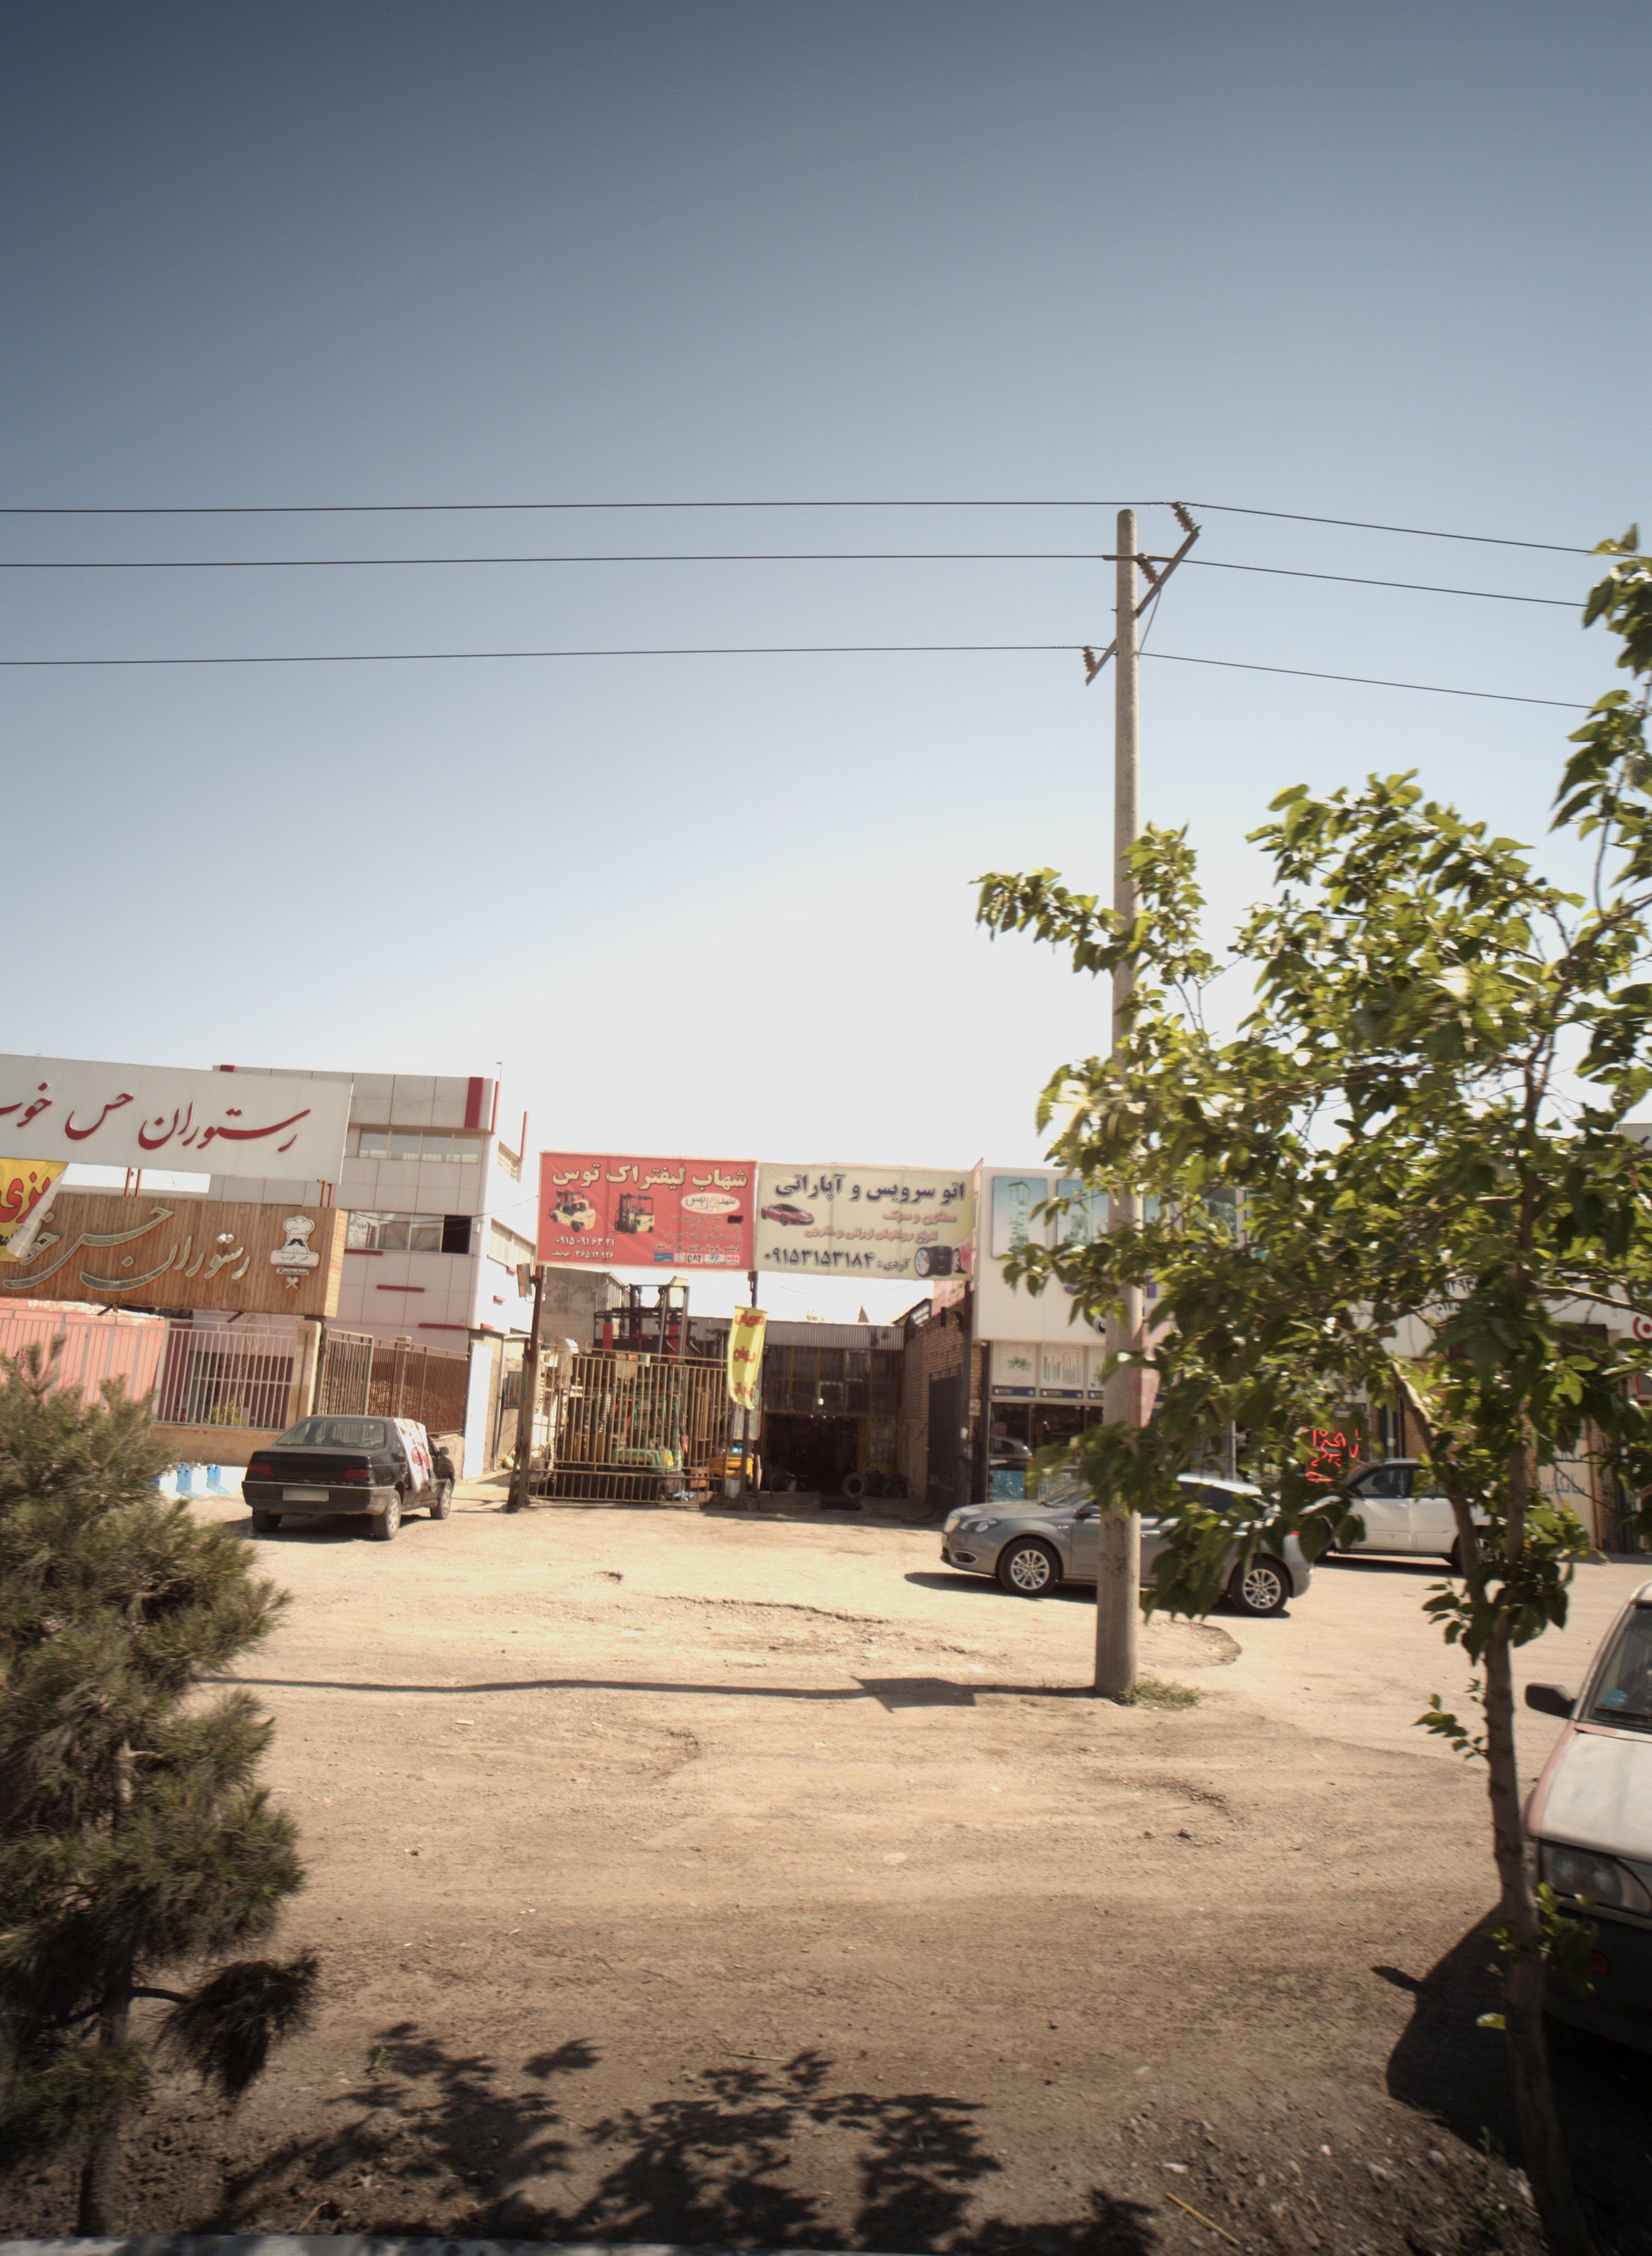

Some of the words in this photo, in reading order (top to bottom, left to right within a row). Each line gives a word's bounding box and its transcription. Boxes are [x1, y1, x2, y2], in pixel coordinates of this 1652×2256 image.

[64, 1093, 135, 1140] حس
[138, 1102, 311, 1152] رستوران
[552, 1163, 601, 1187] توس
[606, 1164, 687, 1190] لیفتراک
[692, 1168, 748, 1191] شهاب
[775, 1174, 847, 1201] آپاراتی
[850, 1184, 861, 1201] و
[866, 1184, 936, 1203] سرویس
[941, 1181, 966, 1205] اتو
[883, 1210, 912, 1223] سبک
[912, 1212, 921, 1224] و
[922, 1211, 958, 1225] سنگین
[836, 1228, 844, 1239] و
[915, 1229, 939, 1244] انواع
[3, 1207, 174, 1289] حس
[687, 1255, 702, 1263] CAT
[764, 1247, 876, 1268] ۰۹۱۵۳۱۵۳۱۸۴
[80, 1233, 251, 1291] رستوران
